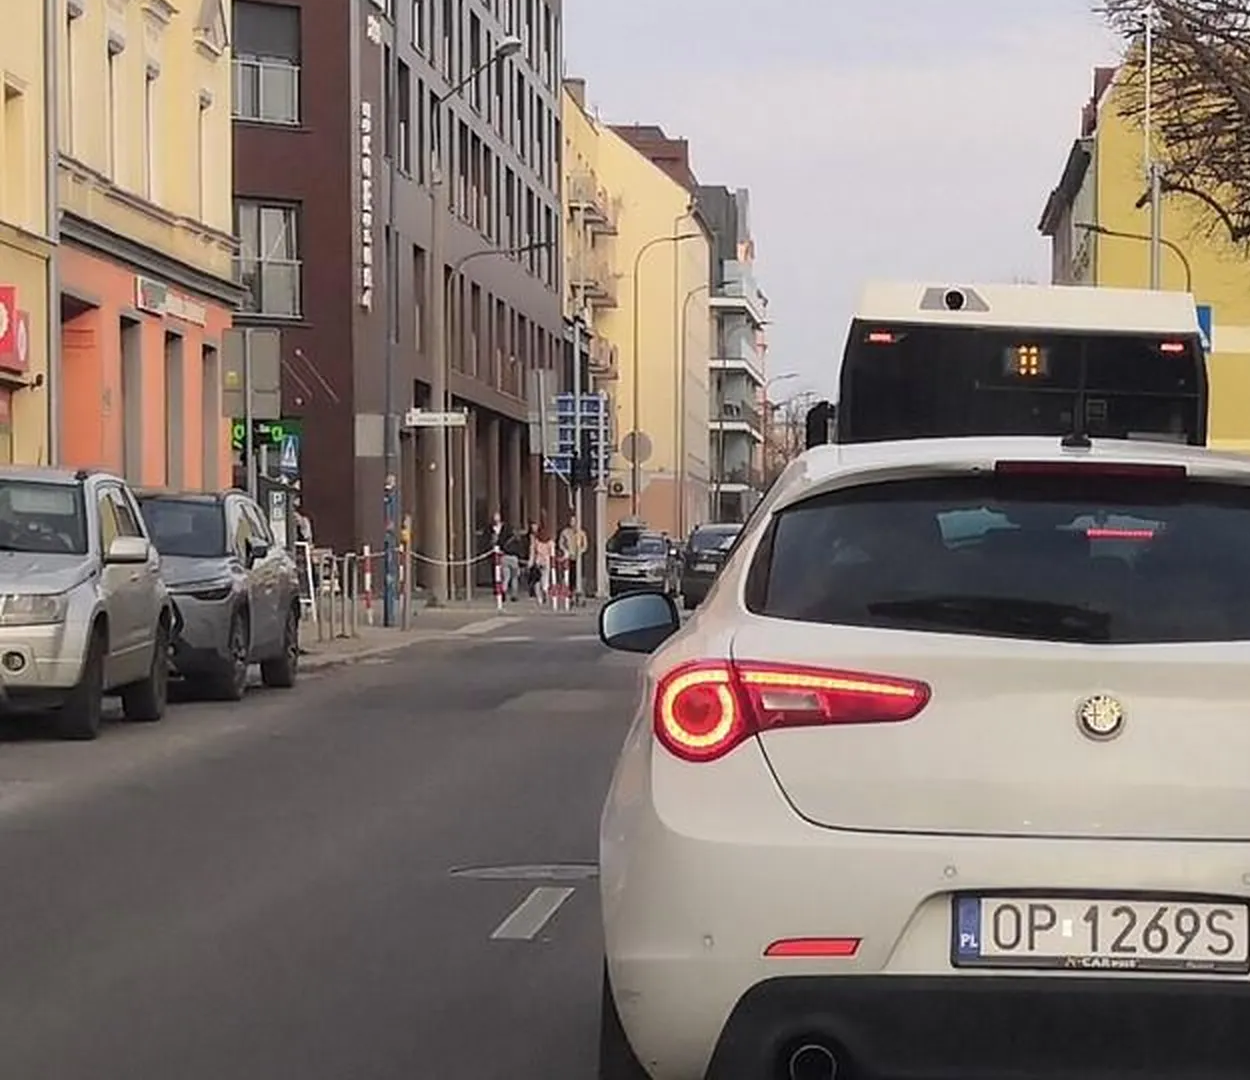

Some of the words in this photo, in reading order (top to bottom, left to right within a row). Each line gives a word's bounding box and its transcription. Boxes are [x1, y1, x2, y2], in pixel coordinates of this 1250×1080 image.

[960, 933, 979, 949] PL
[992, 903, 1057, 952] OP
[1083, 905, 1235, 956] 1269S
